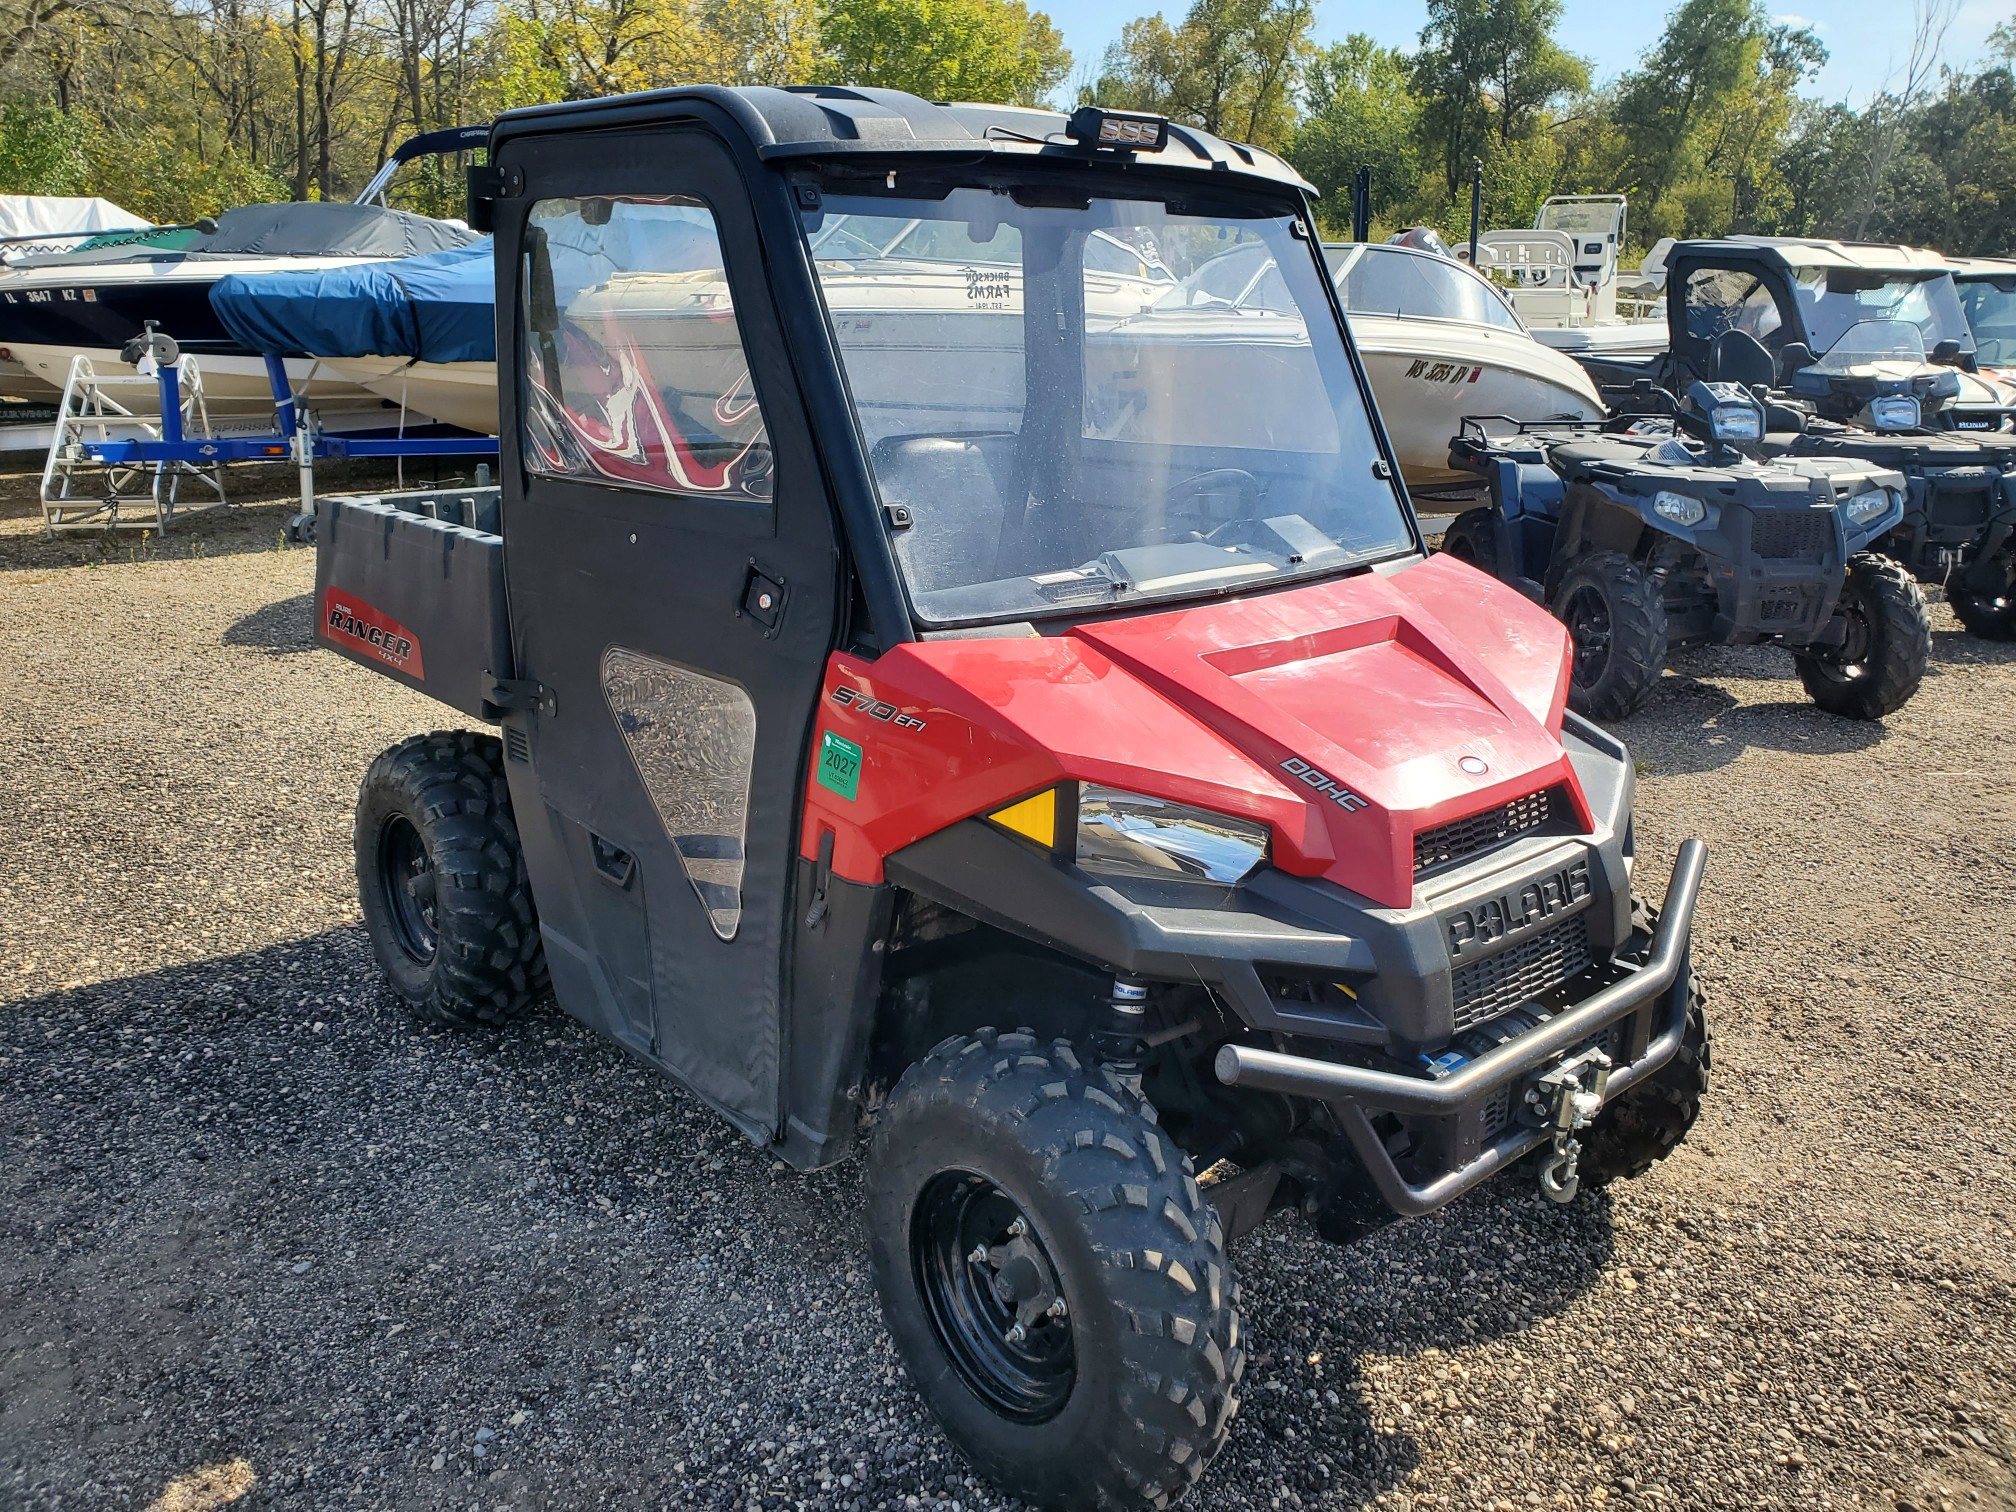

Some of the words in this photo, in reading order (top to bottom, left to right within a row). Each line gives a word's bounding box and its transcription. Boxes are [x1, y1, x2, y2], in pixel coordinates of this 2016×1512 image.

[4, 292, 18, 303] IL
[26, 290, 52, 303] 3647
[61, 288, 77, 301] KZ
[1404, 359, 1429, 379] WS
[1958, 421, 1989, 429] HONDA
[329, 609, 412, 660] RANGER
[831, 684, 898, 722] 570
[893, 713, 927, 732] EFI
[825, 749, 857, 777] 2027
[1279, 756, 1370, 813] DOHC
[1446, 859, 1591, 957] POLARIS
[1115, 985, 1145, 997] POLARIS
